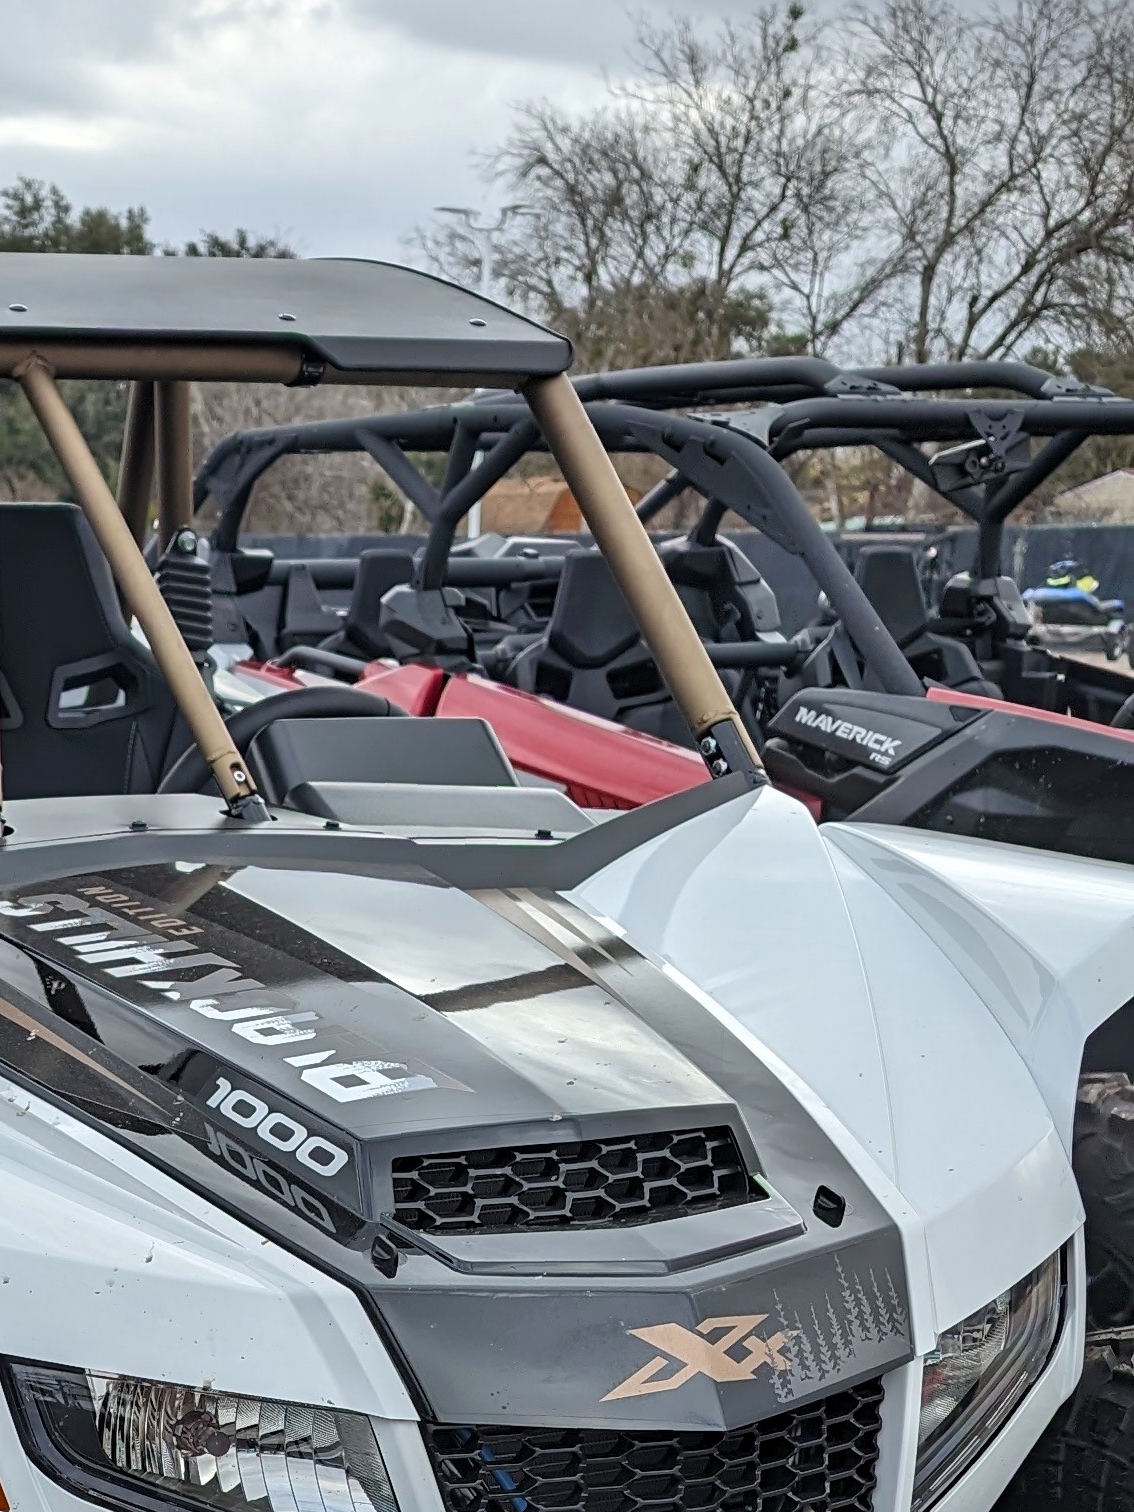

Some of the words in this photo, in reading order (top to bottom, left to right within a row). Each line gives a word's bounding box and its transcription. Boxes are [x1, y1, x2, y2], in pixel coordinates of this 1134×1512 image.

[794, 706, 902, 756] MAVERICK
[77, 886, 204, 937] EDITION
[205, 1076, 348, 1177] 1000
